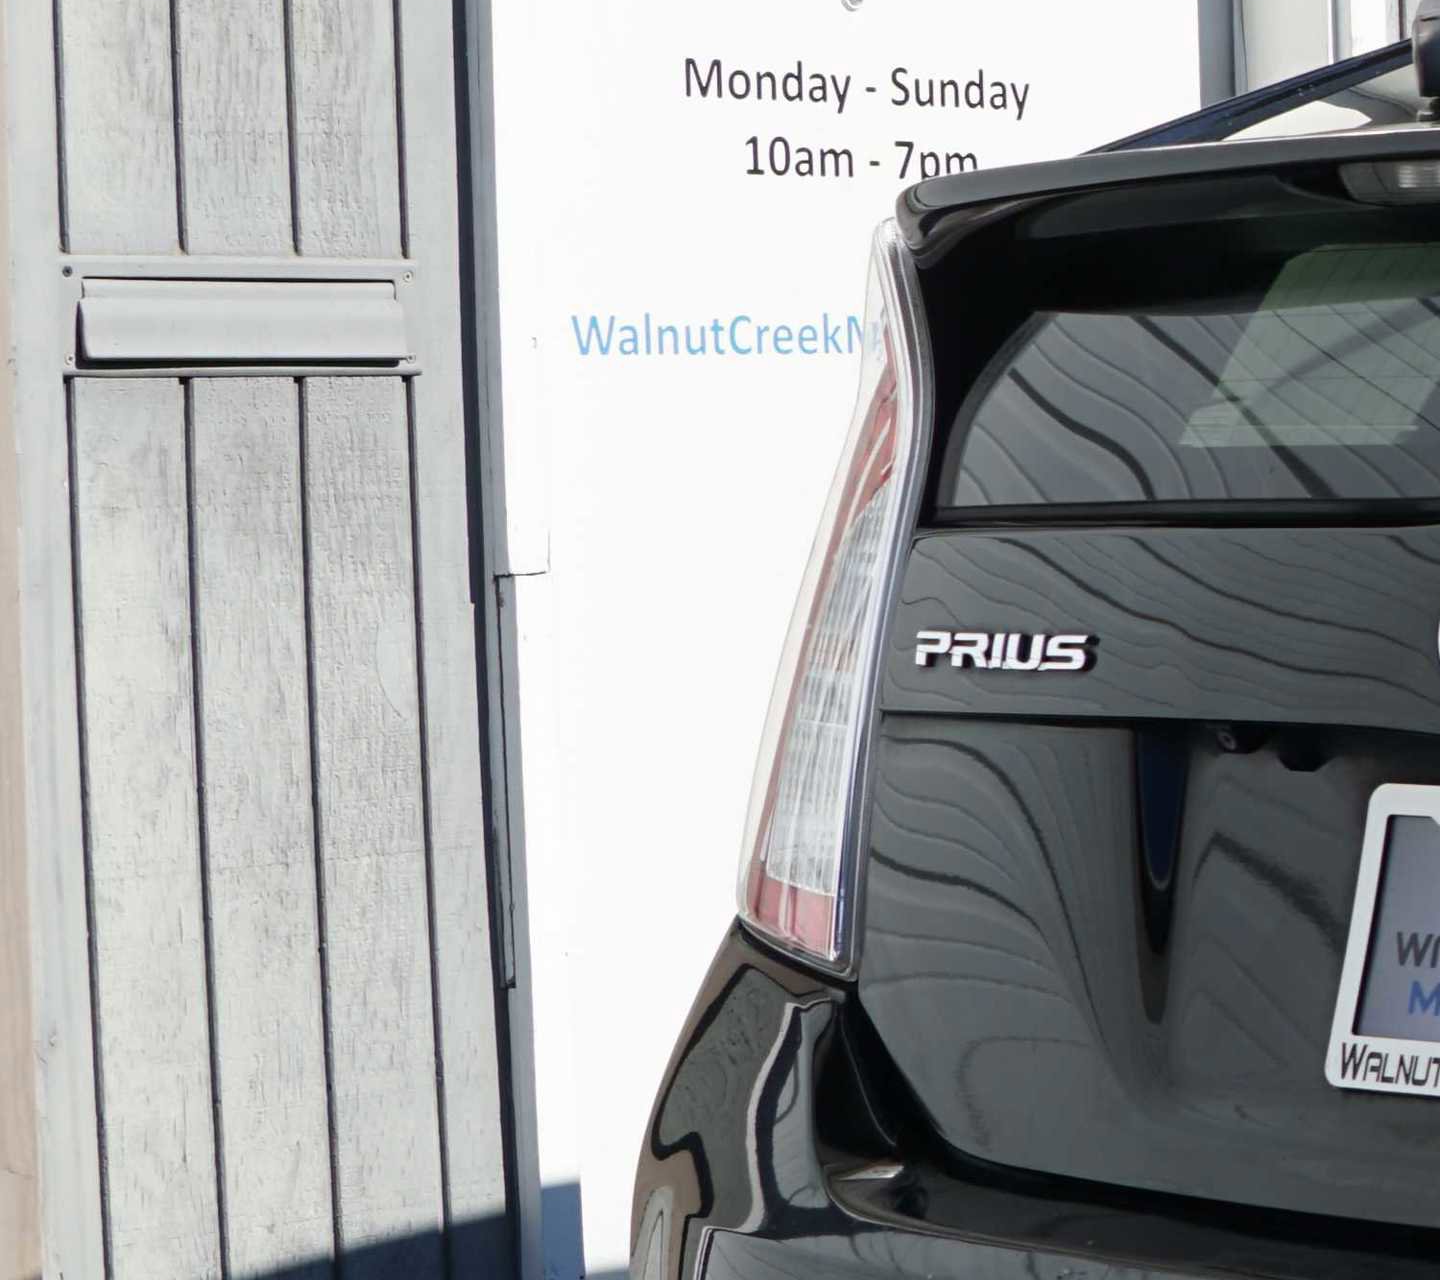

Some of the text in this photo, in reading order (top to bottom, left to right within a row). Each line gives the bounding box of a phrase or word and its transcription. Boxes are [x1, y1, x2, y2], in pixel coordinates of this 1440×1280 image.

[683, 58, 851, 114] Monday
[891, 67, 1029, 121] Sunday
[745, 136, 853, 178] 10am
[894, 140, 978, 179] 7pm
[915, 630, 1090, 671] PRIUS
